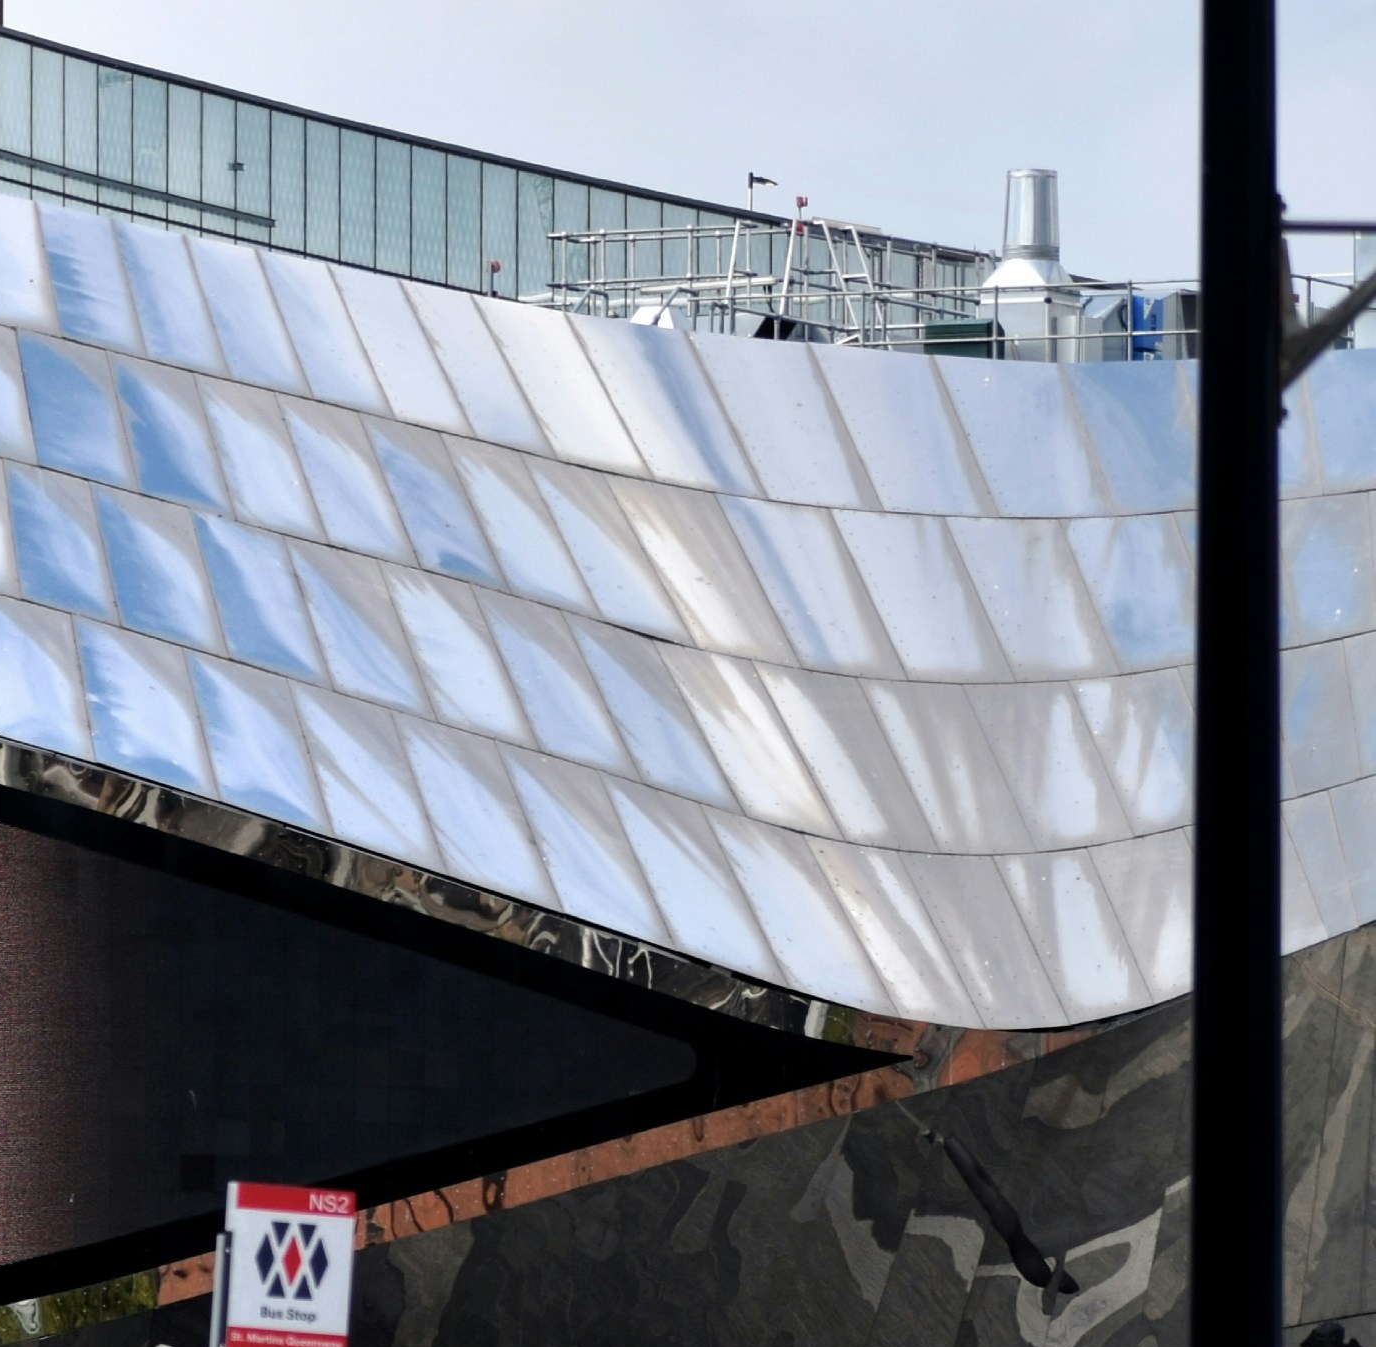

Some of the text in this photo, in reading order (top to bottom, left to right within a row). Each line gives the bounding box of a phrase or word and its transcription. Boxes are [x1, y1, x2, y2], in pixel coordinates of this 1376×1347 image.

[309, 1194, 349, 1214] NS2
[260, 1306, 317, 1324] Bus Stop
